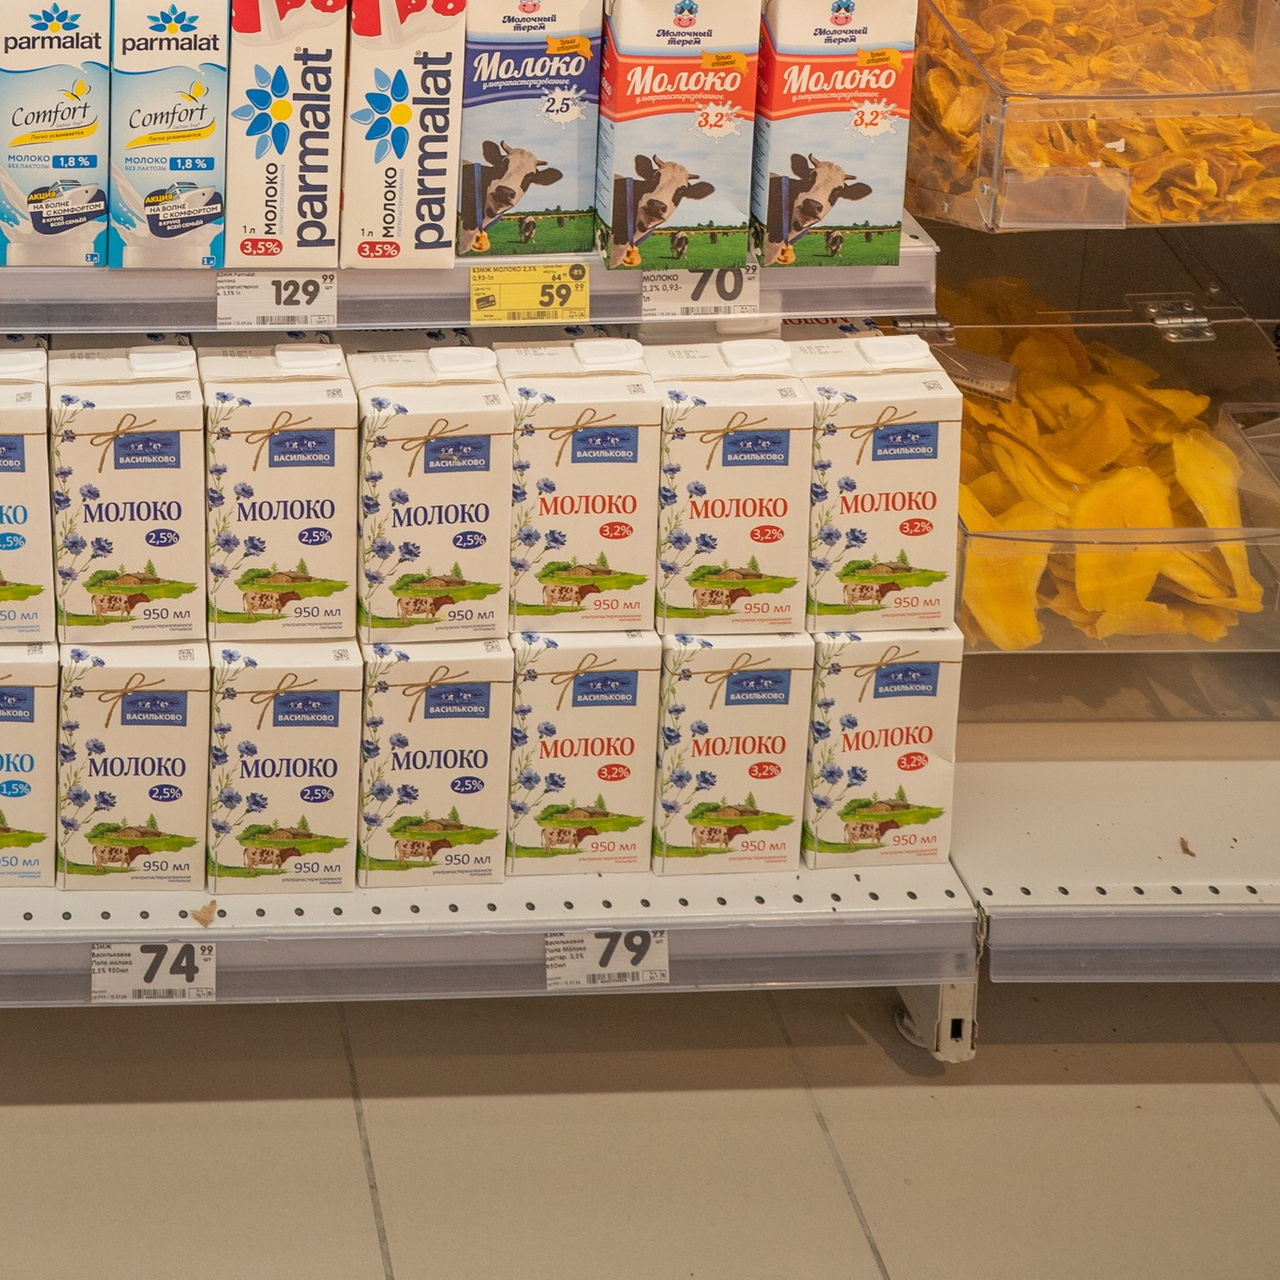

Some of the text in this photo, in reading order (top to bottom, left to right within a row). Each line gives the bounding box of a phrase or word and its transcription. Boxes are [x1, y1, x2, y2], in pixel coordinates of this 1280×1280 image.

[503, 15, 556, 26] Молочный
[473, 51, 585, 80] Молоко
[293, 47, 333, 249] parmalat
[243, 241, 279, 255] 3,5%
[272, 280, 320, 307] 129
[689, 497, 788, 519] МОЛОКО
[752, 528, 782, 541] 3,2%
[597, 930, 650, 967] 79
[138, 945, 200, 984] 74
